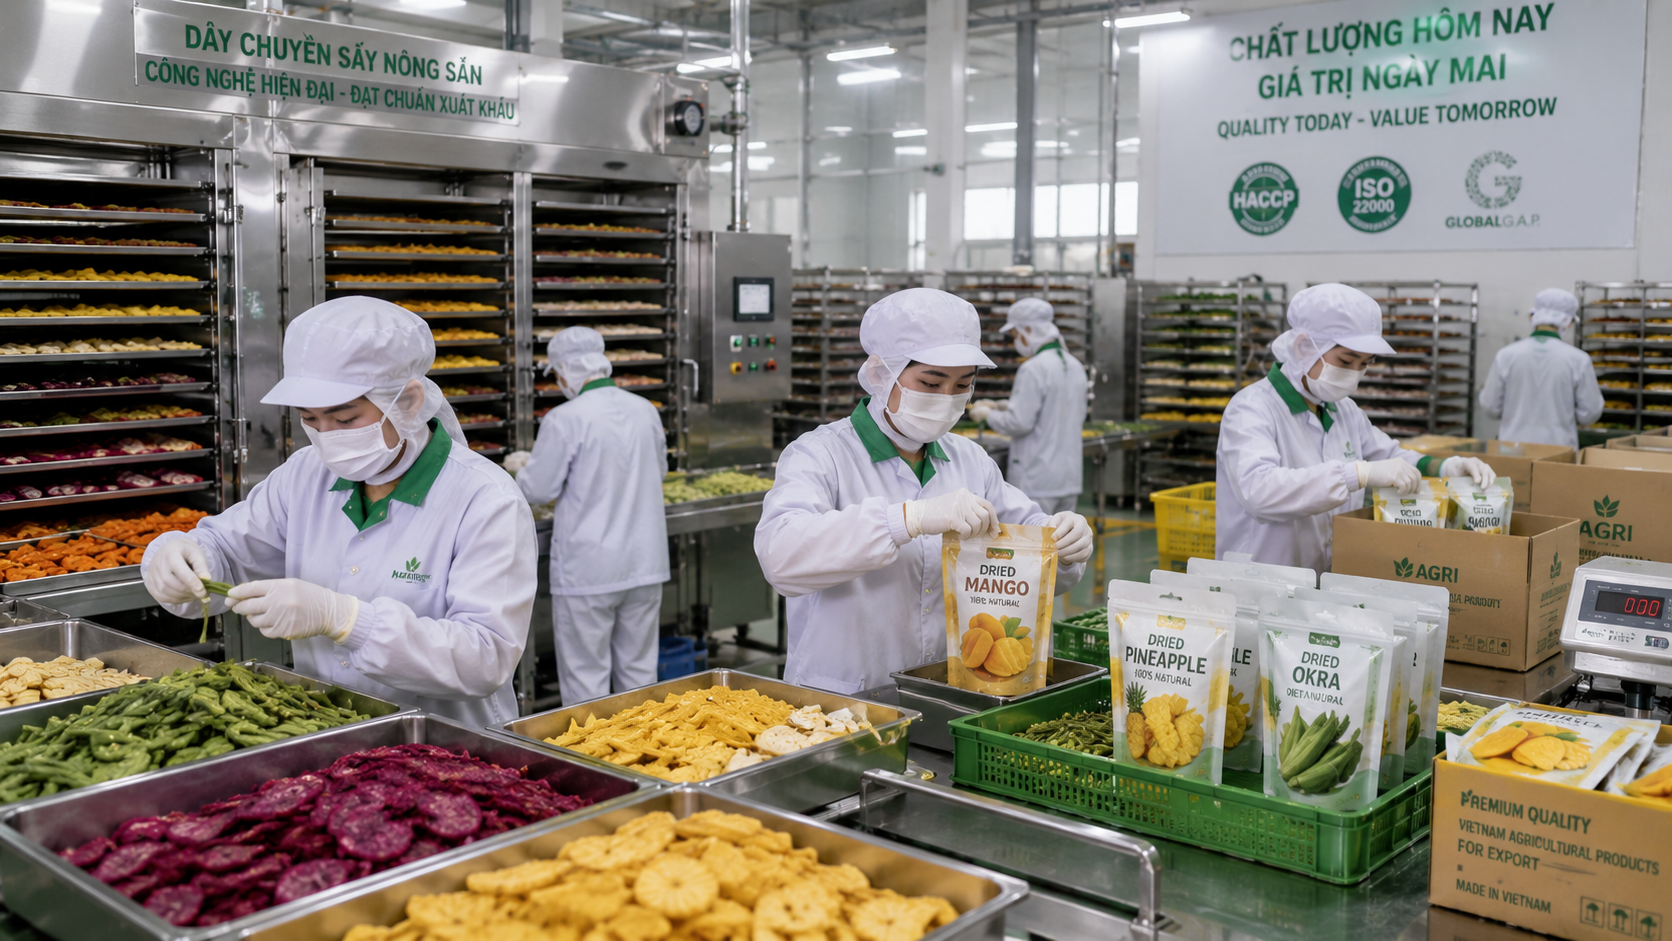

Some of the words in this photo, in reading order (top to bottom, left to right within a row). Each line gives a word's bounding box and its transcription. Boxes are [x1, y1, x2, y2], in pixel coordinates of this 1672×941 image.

[1230, 22, 1299, 61] CHẤT
[1306, 20, 1403, 56] LƯỢNG
[1413, 7, 1481, 44] HÔM
[1492, 2, 1555, 36] NAY
[185, 21, 233, 53] DÂY
[240, 32, 331, 66] CHUYỀN
[384, 50, 439, 80] NÔNG
[145, 57, 200, 87] CÔNG
[261, 72, 301, 101] HIỆN
[305, 79, 334, 104] ĐẠI
[350, 84, 380, 109] ĐẠT
[1259, 65, 1303, 99] GIÁ
[1311, 67, 1352, 100] TRỊ
[1362, 54, 1440, 91] NGÀY
[1450, 53, 1506, 84] MAI
[1217, 115, 1290, 140] QUALITY
[1294, 112, 1352, 132] TODAY
[1369, 106, 1430, 127] VALUE
[1435, 97, 1557, 123] TOMORROW
[1233, 189, 1295, 210] HACCP
[1355, 177, 1395, 199] ISO
[1353, 198, 1395, 214] 22000
[1579, 520, 1633, 542] AGRI
[979, 564, 1016, 578] DRIED
[1415, 563, 1459, 583] AGRI
[965, 576, 1030, 596] MANGO
[1147, 633, 1185, 650] DRIED
[1125, 646, 1208, 675] PINEAPPLE
[1301, 651, 1340, 669] DRIED
[1292, 665, 1341, 691] OKRA
[1461, 789, 1524, 819] PREMIUM
[1528, 806, 1592, 834] QUALITY
[1458, 838, 1484, 857] FOR
[1488, 846, 1540, 871] EXPORT
[1509, 830, 1593, 861] AGRICULTURAL
[1596, 849, 1660, 876] PRODUCTS
[1456, 878, 1486, 897] MADE
[1489, 886, 1500, 901] IN
[1502, 890, 1551, 914] VIETNAM
